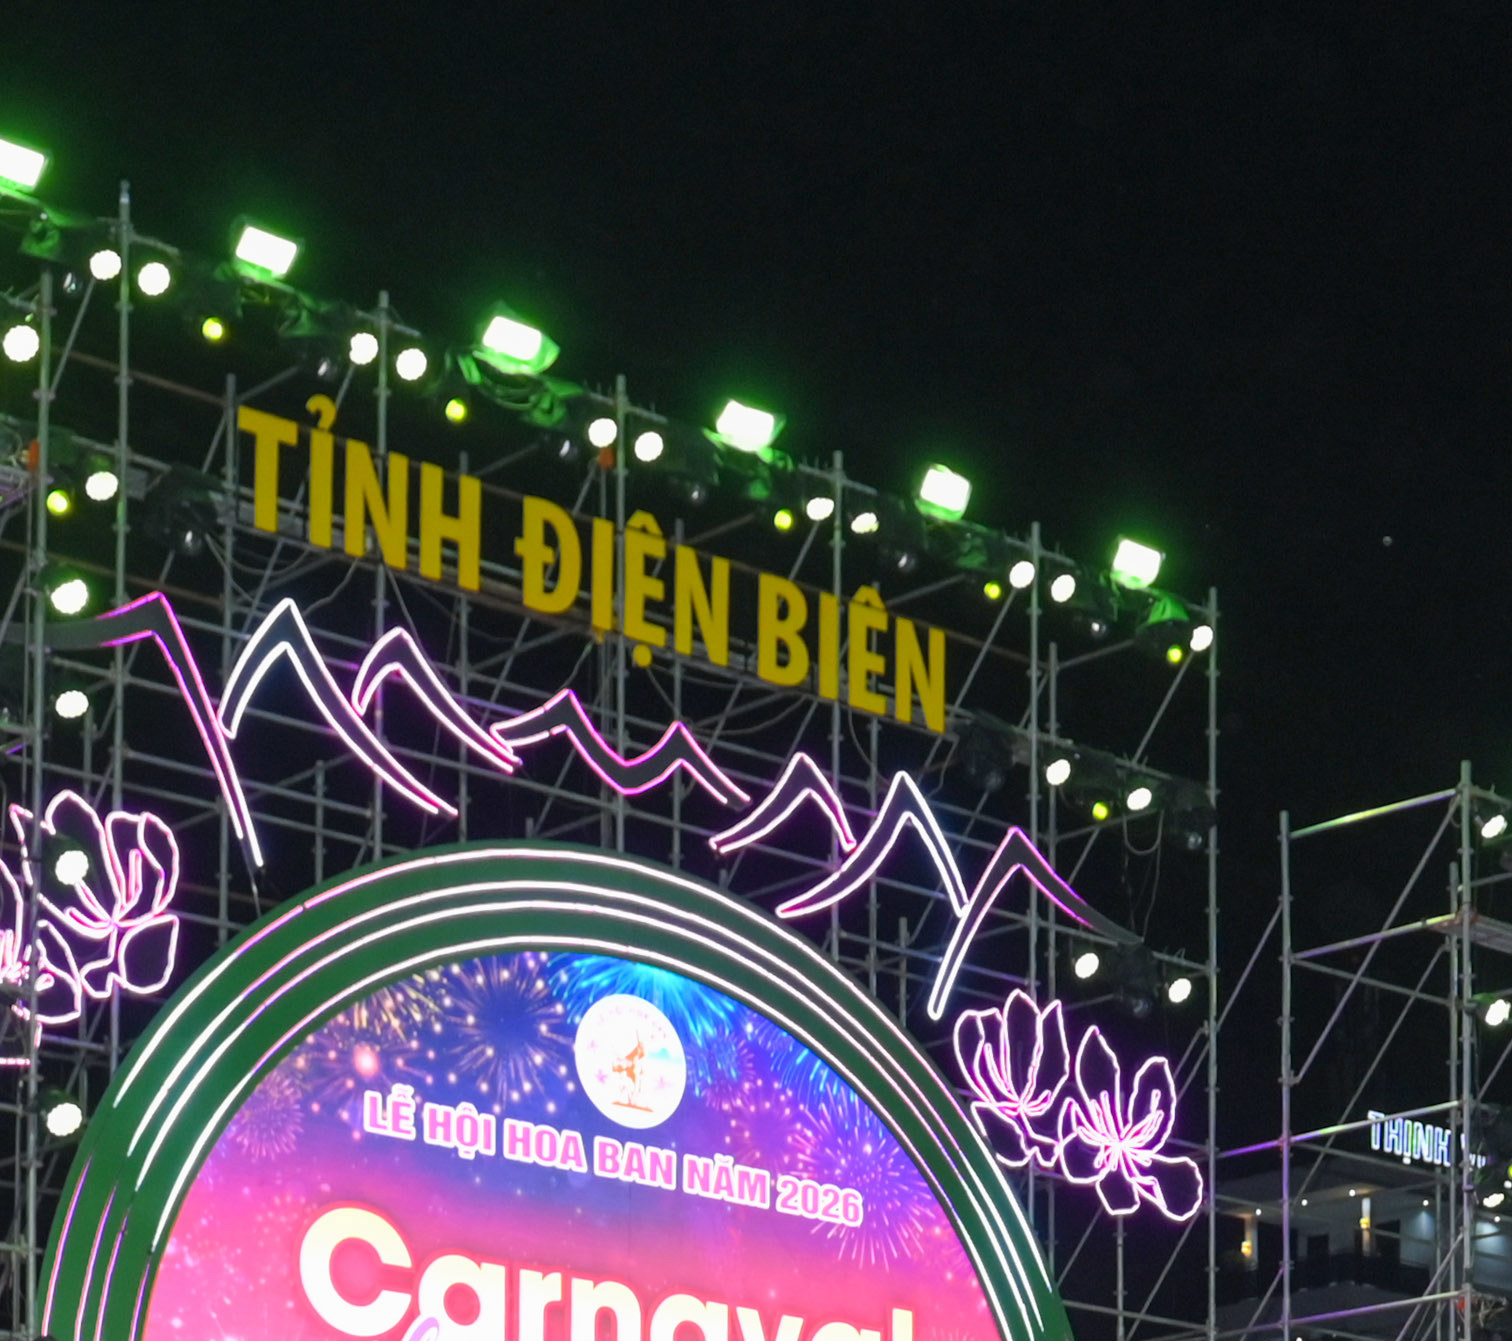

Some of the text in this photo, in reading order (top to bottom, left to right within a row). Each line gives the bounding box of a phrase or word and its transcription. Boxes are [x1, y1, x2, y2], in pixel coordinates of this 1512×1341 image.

[236, 394, 947, 733] TỈNH ĐIỆN BIÊN
[364, 1084, 863, 1227] LỄ HỘI HOA BAN NĂM 2026
